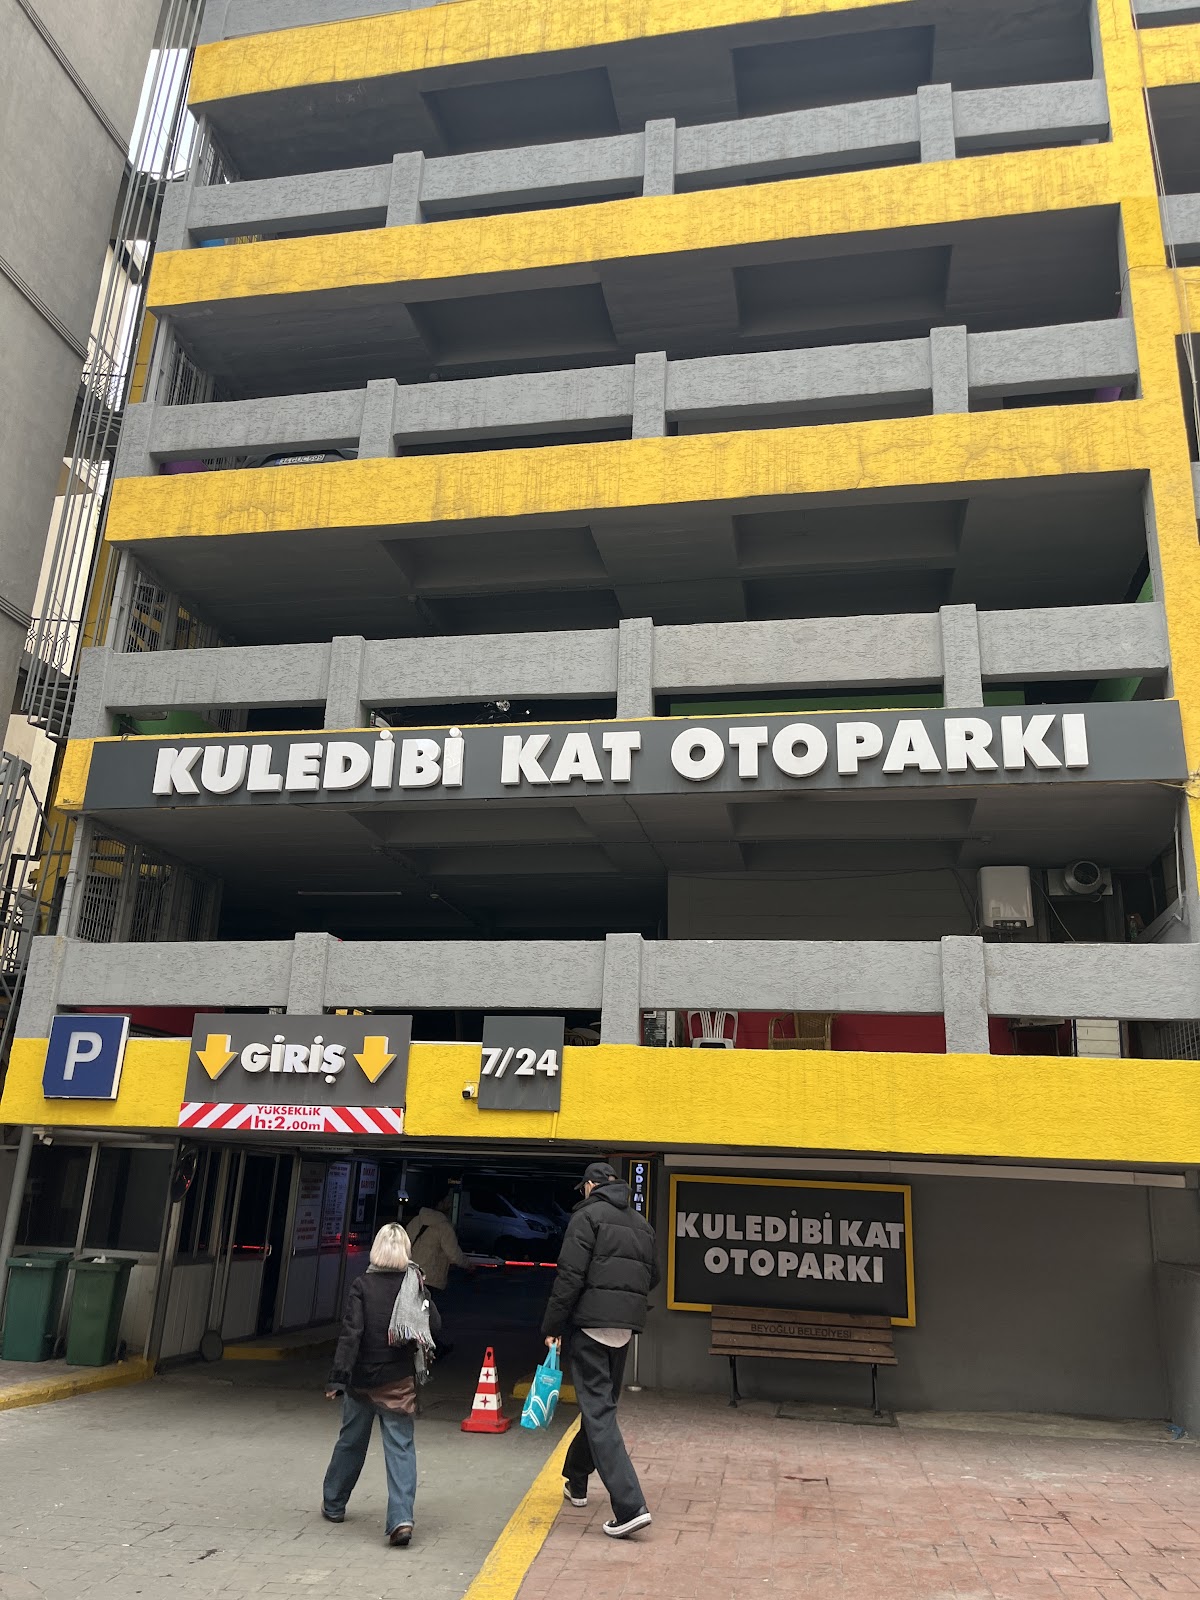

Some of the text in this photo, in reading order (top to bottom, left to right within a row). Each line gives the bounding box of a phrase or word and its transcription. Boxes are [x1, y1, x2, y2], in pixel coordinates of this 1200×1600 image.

[152, 713, 1090, 796] KULEDİBİ KAT OTOPARKI
[63, 1032, 103, 1081] P
[240, 1034, 347, 1084] GİRİŞ
[481, 1046, 559, 1079] 7/24
[633, 1163, 645, 1212] ÖDEME
[677, 1209, 904, 1249] KULEDİBİ KAT
[704, 1246, 884, 1284] OTOPARKI
[751, 1323, 854, 1339] BEYOĞLU BELEDİYESİ
